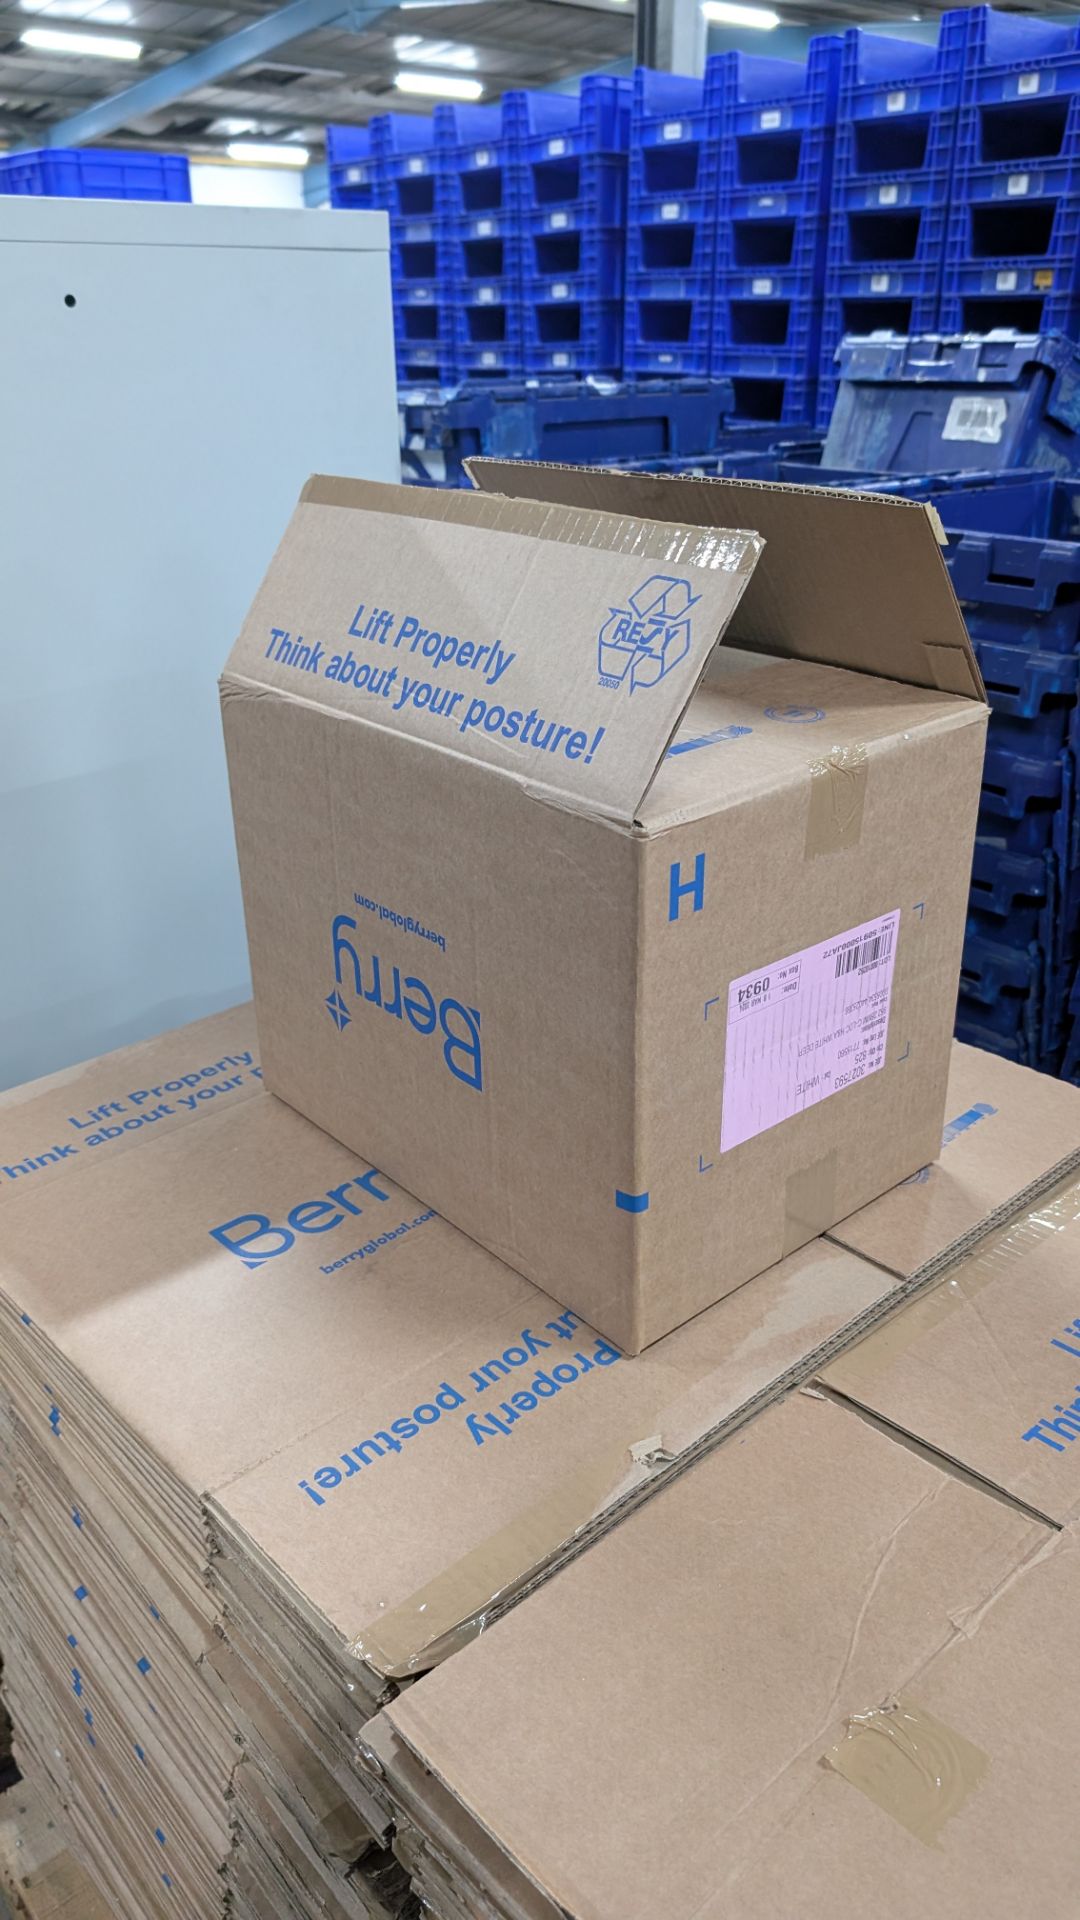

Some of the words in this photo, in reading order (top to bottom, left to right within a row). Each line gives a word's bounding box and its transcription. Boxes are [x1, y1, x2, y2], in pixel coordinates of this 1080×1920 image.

[348, 604, 393, 644] Lift
[393, 615, 517, 686] Properly
[265, 627, 324, 674] Think
[324, 651, 398, 699] about
[392, 675, 465, 718] your
[460, 698, 606, 764] posture!
[668, 852, 706, 922] H
[354, 893, 446, 952] berryglobal.com
[332, 914, 483, 1092] Berry
[737, 975, 770, 1003] 0934
[777, 969, 787, 981] No:
[781, 981, 796, 995] Date:
[788, 964, 798, 976] Box
[69, 1099, 126, 1130] Lift
[127, 1051, 254, 1106] Properly
[796, 1073, 819, 1096] WHITE
[833, 1062, 866, 1090] 3027593
[0, 1143, 80, 1179] hink
[84, 1103, 176, 1148] about
[176, 1073, 244, 1111] your
[208, 1169, 390, 1269] Berr
[464, 1339, 621, 1447] Properly
[474, 1328, 552, 1394] your
[298, 1382, 468, 1506] posture!
[1021, 1385, 1080, 1452] Thi
